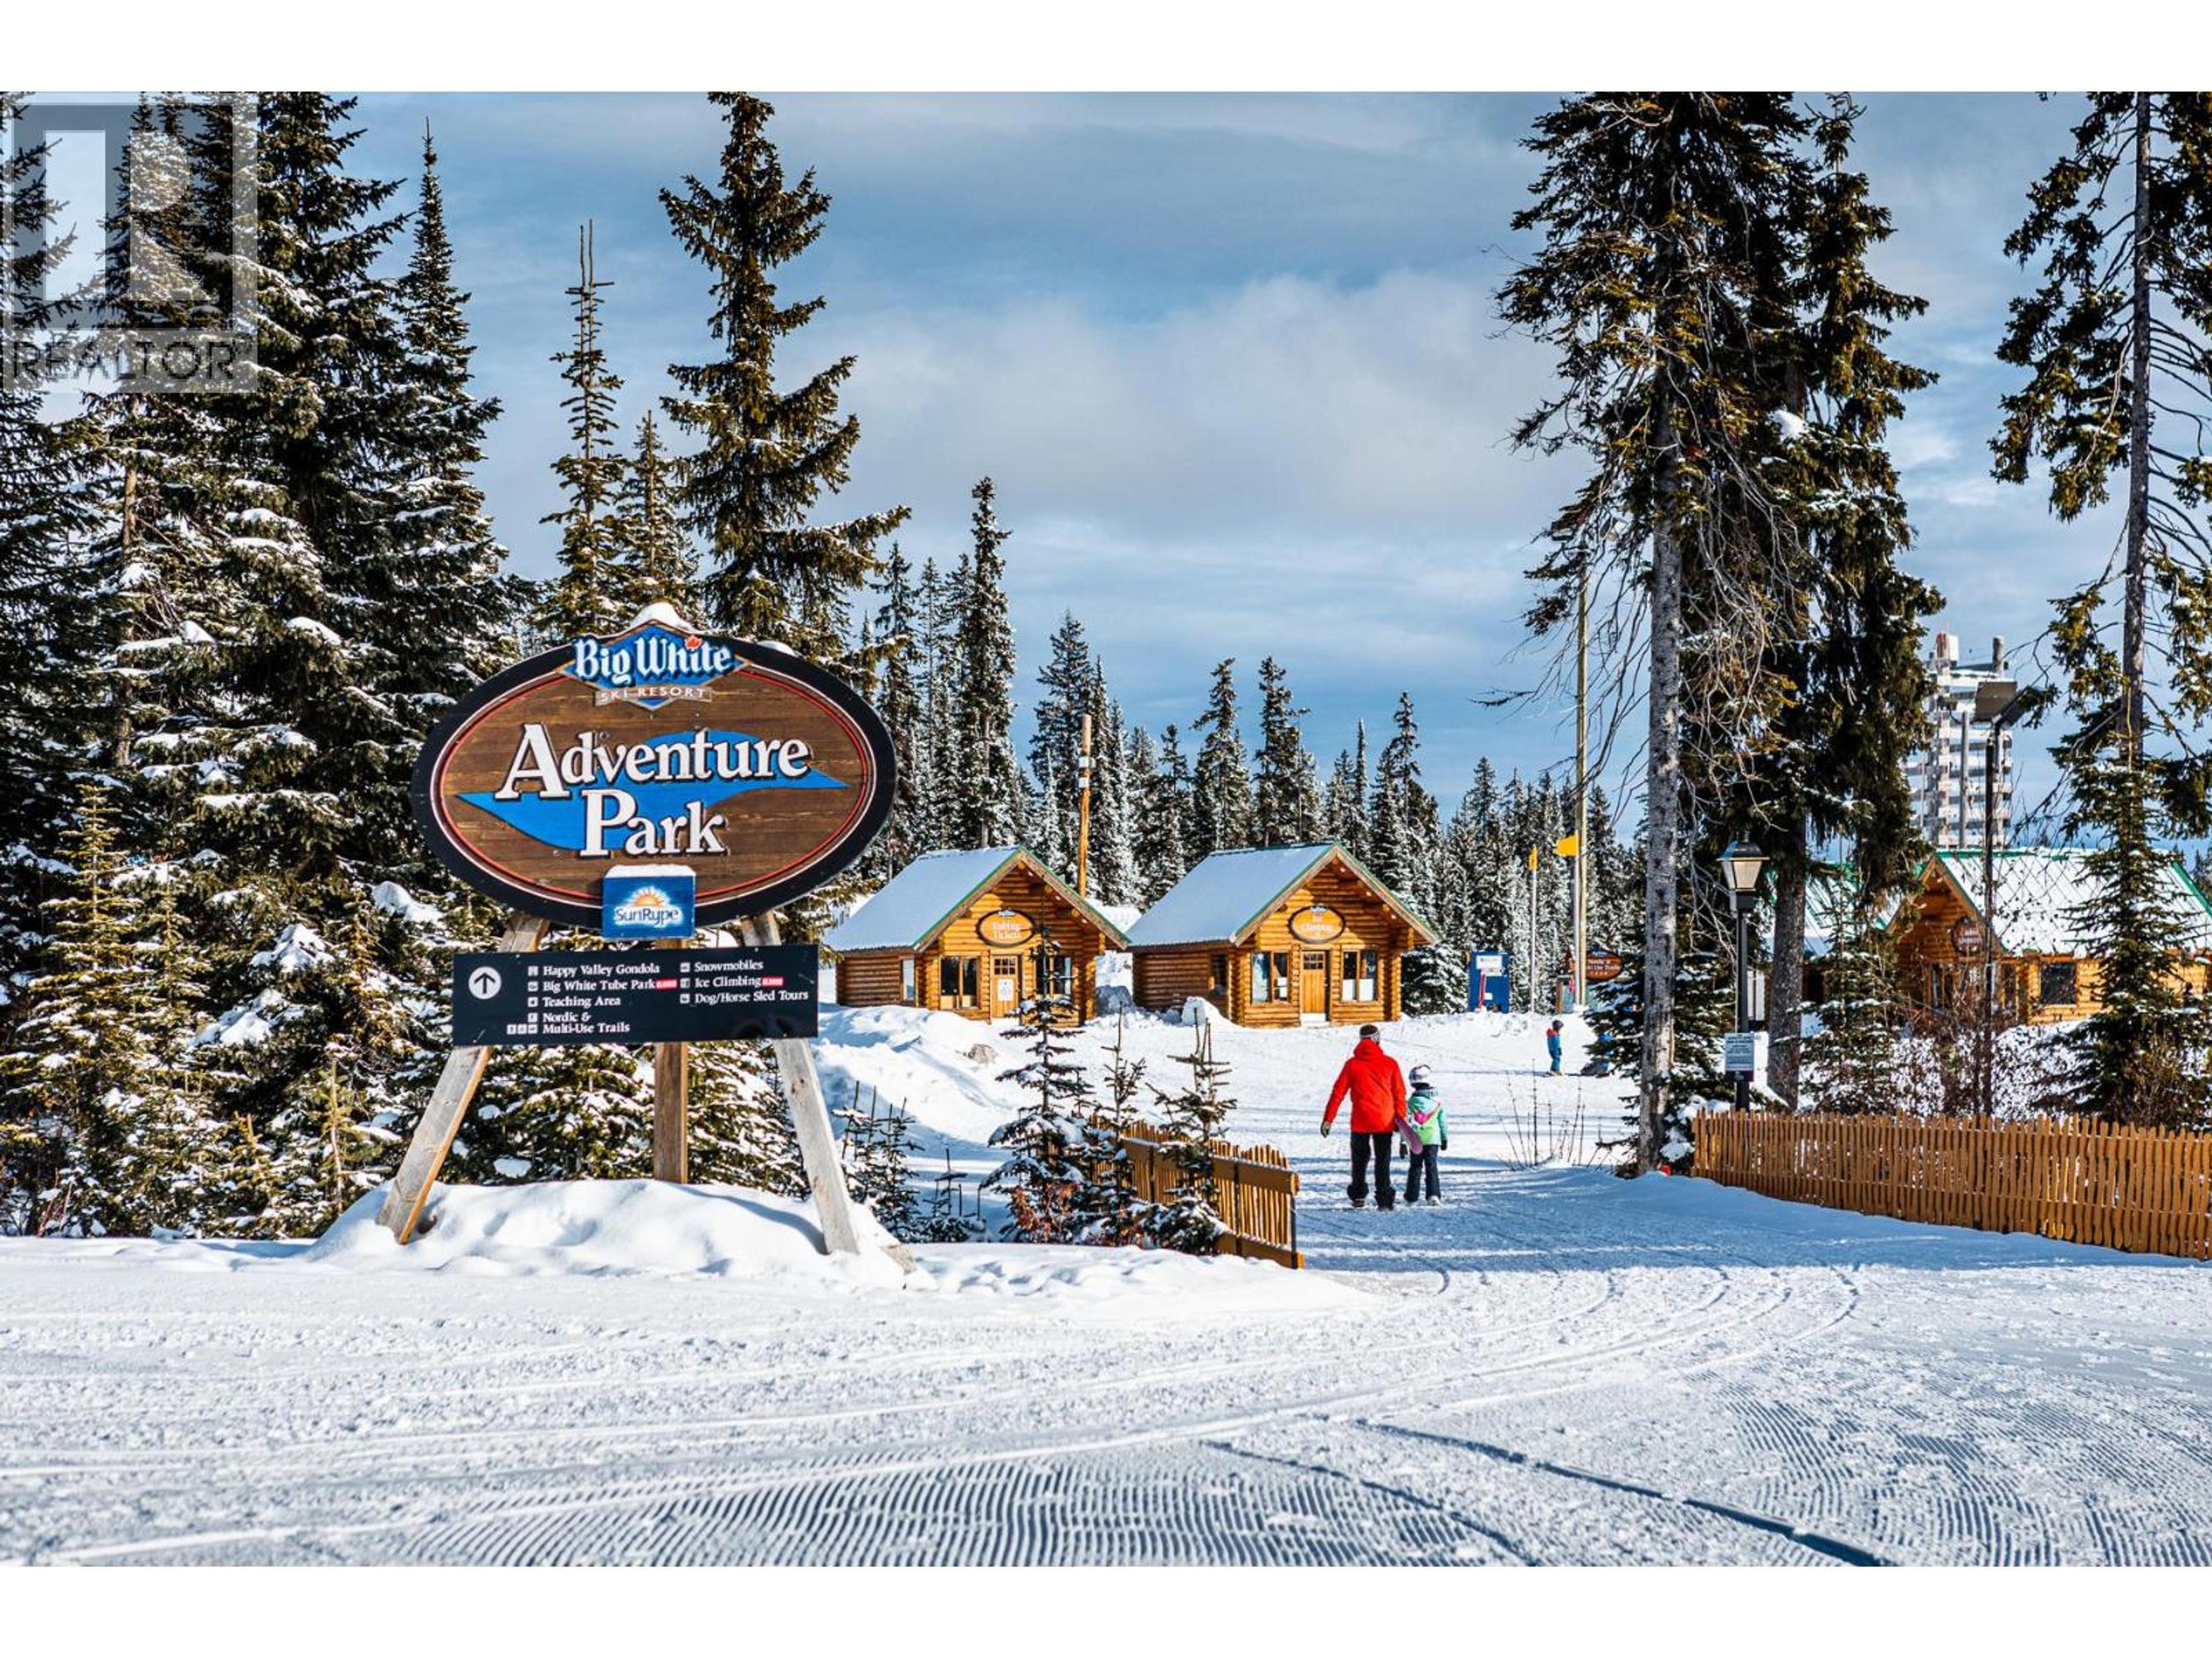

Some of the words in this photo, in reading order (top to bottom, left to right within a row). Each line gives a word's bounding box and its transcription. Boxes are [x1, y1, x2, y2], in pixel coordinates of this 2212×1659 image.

[574, 636, 632, 685] Big
[634, 636, 732, 677] White
[601, 688, 628, 702] SKI
[637, 687, 705, 698] RESORT
[495, 723, 810, 800] Adventure
[579, 789, 727, 857] Park
[616, 908, 679, 926] SunRype
[543, 965, 577, 978] Happy
[581, 964, 613, 976] Valley
[616, 963, 660, 975] Gondola
[694, 959, 763, 972] Snowmobiles
[543, 980, 561, 993] Big
[564, 980, 597, 991] White
[600, 979, 627, 990] Tube
[631, 979, 656, 990] Park
[695, 978, 710, 988] Ice
[713, 976, 762, 988] Climbing
[542, 995, 592, 1008] Teaching
[594, 996, 621, 1006] Area
[695, 991, 750, 1005] Dog/Horse
[753, 990, 775, 1002] Sled
[778, 989, 809, 1001] Tours
[543, 1011, 578, 1022] Nordic
[581, 1012, 592, 1022] &
[542, 1024, 594, 1035] Multi-Use
[597, 1021, 631, 1033] Trails
